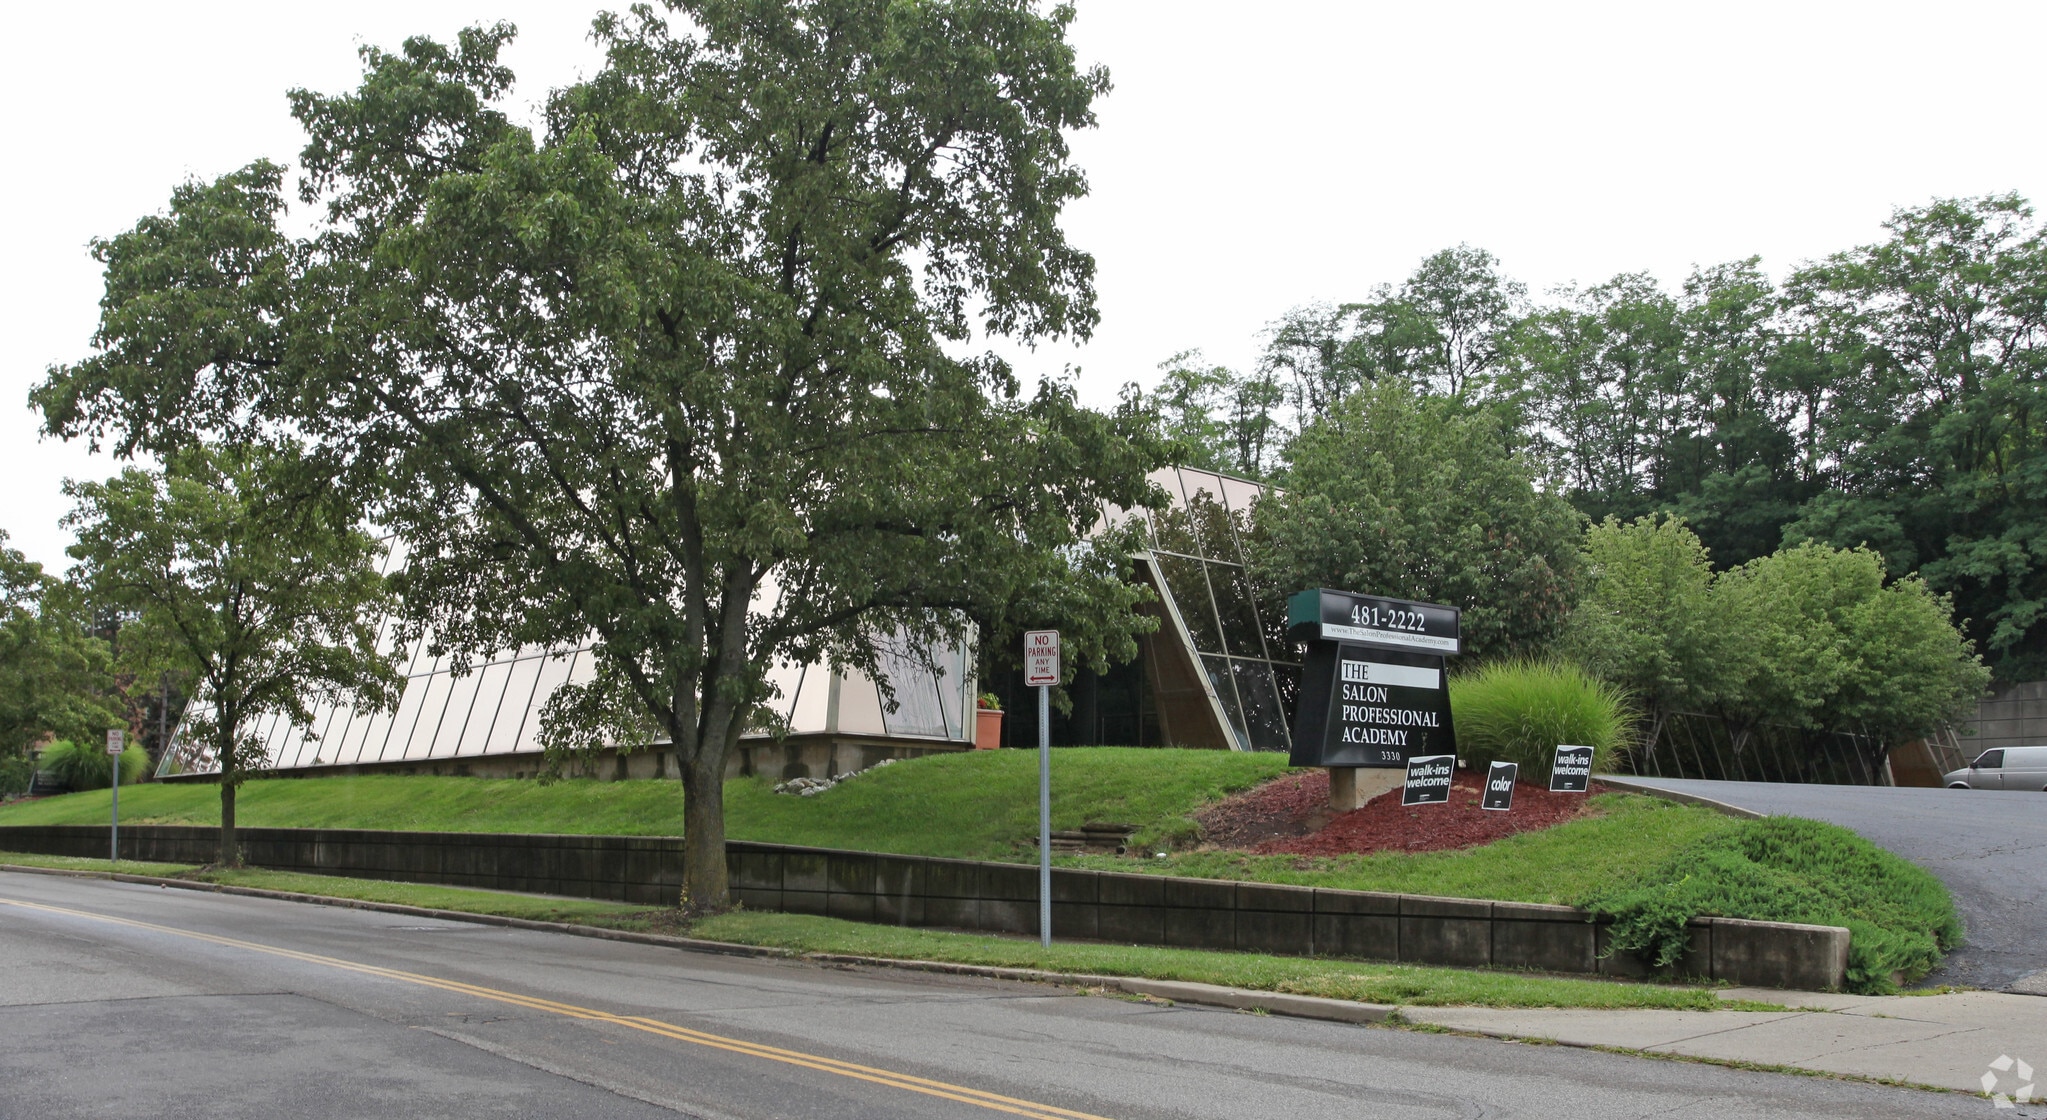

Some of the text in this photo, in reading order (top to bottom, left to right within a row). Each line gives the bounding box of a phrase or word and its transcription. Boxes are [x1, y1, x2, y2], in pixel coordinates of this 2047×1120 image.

[1351, 604, 1425, 632] 481-2222
[1034, 635, 1049, 645] NO
[1028, 647, 1056, 657] PARKING
[1034, 666, 1050, 674] TIME
[1343, 663, 1369, 680] THE
[1342, 684, 1388, 703] SALON
[1342, 705, 1440, 727] PROFESSIONAL
[1342, 726, 1408, 746] ACADEMY
[1381, 751, 1401, 761] 3330
[1558, 753, 1589, 765] walk-ins
[1410, 764, 1450, 777] walk-ins
[1554, 764, 1589, 776] welcome
[1407, 775, 1450, 788] welcome
[1491, 776, 1512, 792] color
